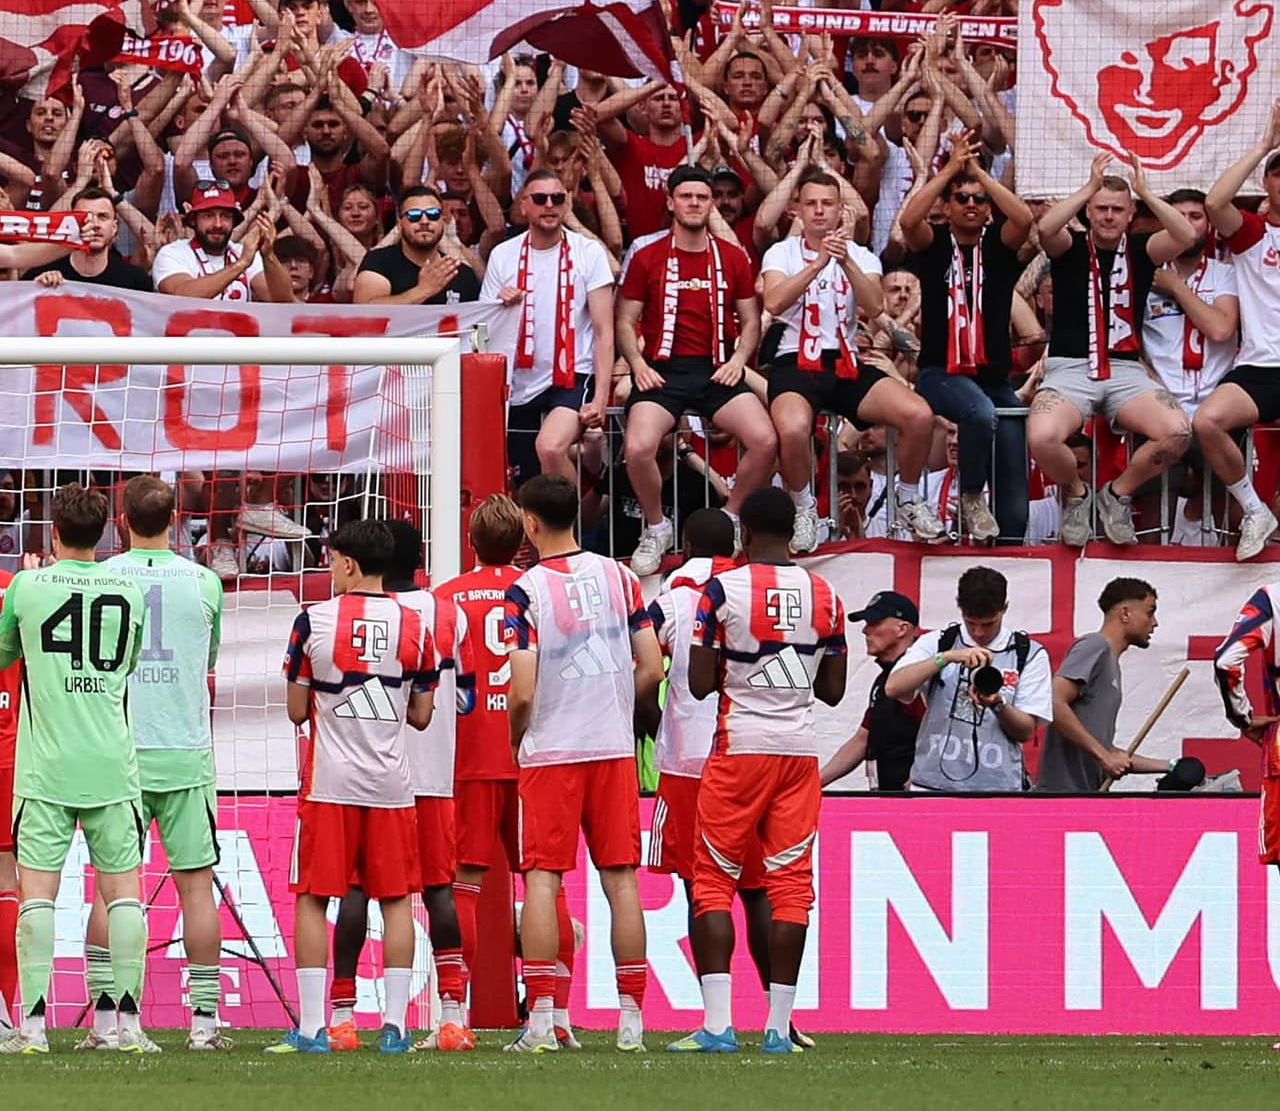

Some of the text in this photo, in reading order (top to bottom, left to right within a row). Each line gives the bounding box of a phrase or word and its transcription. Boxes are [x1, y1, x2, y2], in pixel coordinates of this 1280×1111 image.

[741, 9, 996, 37] WR SIND MÜNCEN
[33, 295, 458, 452] ROT
[35, 574, 48, 584] FC
[51, 575, 90, 586] BAYERN
[453, 591, 466, 602] FC
[40, 592, 131, 673] 40
[142, 584, 174, 662] 1
[131, 666, 180, 684] NEUER
[927, 733, 1003, 769] FOTO
[1065, 831, 1280, 1010] M
